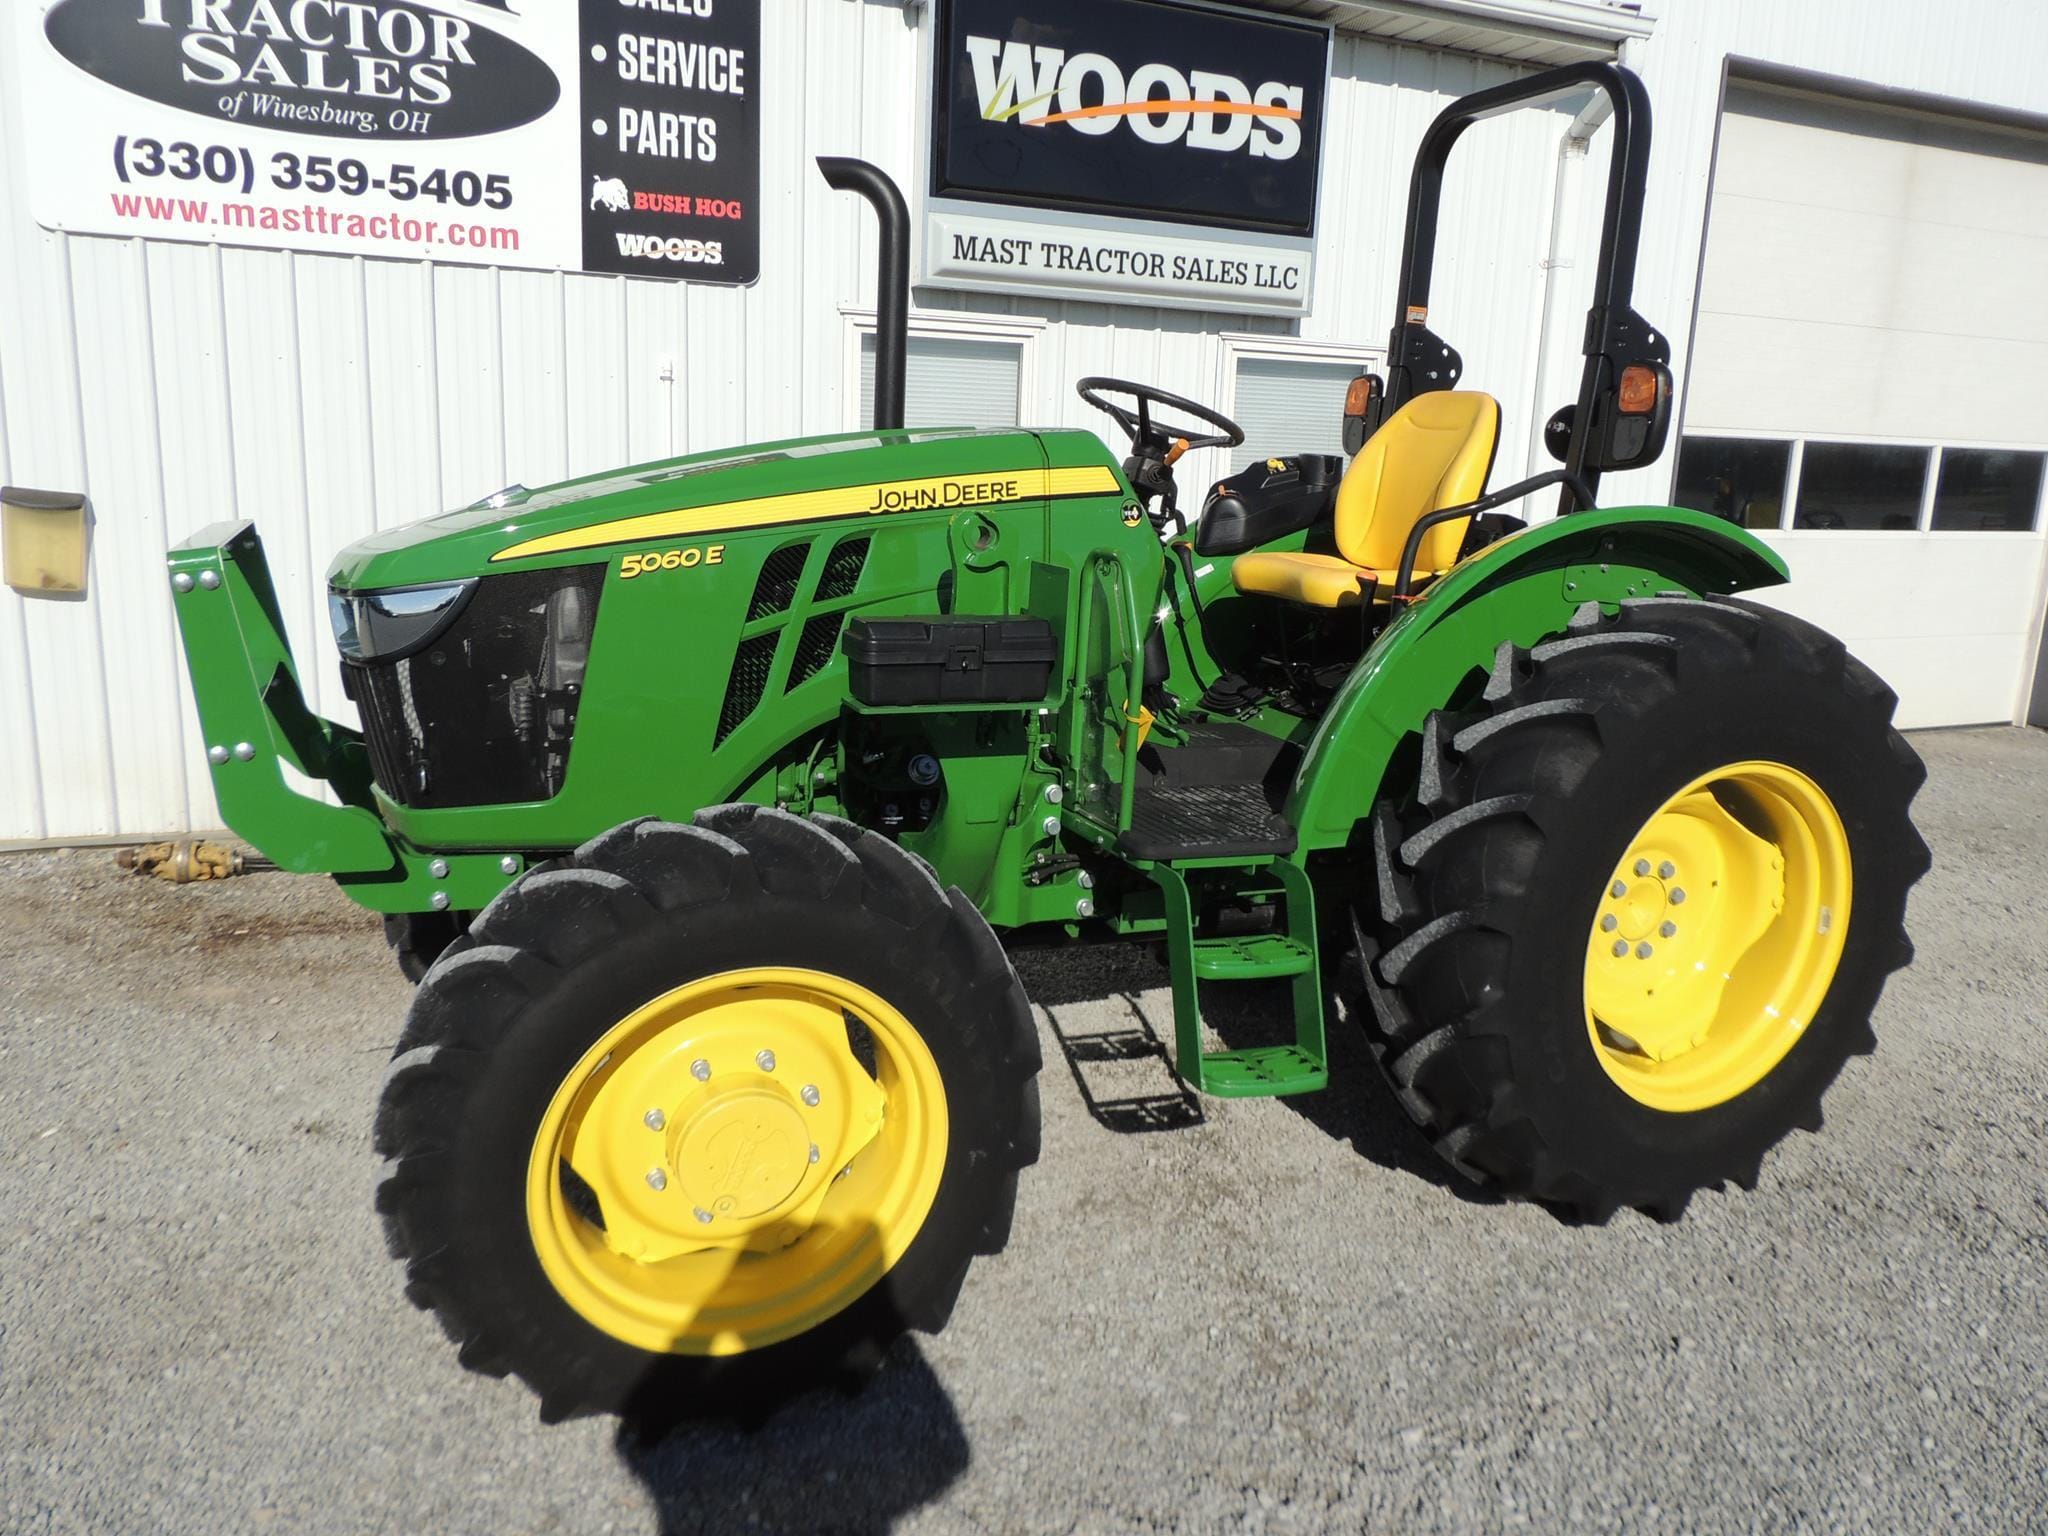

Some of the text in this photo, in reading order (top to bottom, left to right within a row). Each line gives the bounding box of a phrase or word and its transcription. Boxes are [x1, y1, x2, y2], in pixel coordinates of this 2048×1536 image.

[181, 33, 451, 105] SALES
[618, 33, 744, 95] SERVICE
[218, 91, 432, 134] of Winesburg, OH
[966, 35, 1303, 160] WOODS
[618, 107, 717, 163] PARTS
[113, 135, 513, 210] (330) 359-5405
[111, 193, 519, 250] www.masttractor.com
[634, 191, 741, 220] BUSH HOG
[616, 233, 722, 265] WOODS
[952, 234, 1299, 291] MAST TRACTOR SALES LLC
[869, 480, 1018, 511] JOHN DEERE
